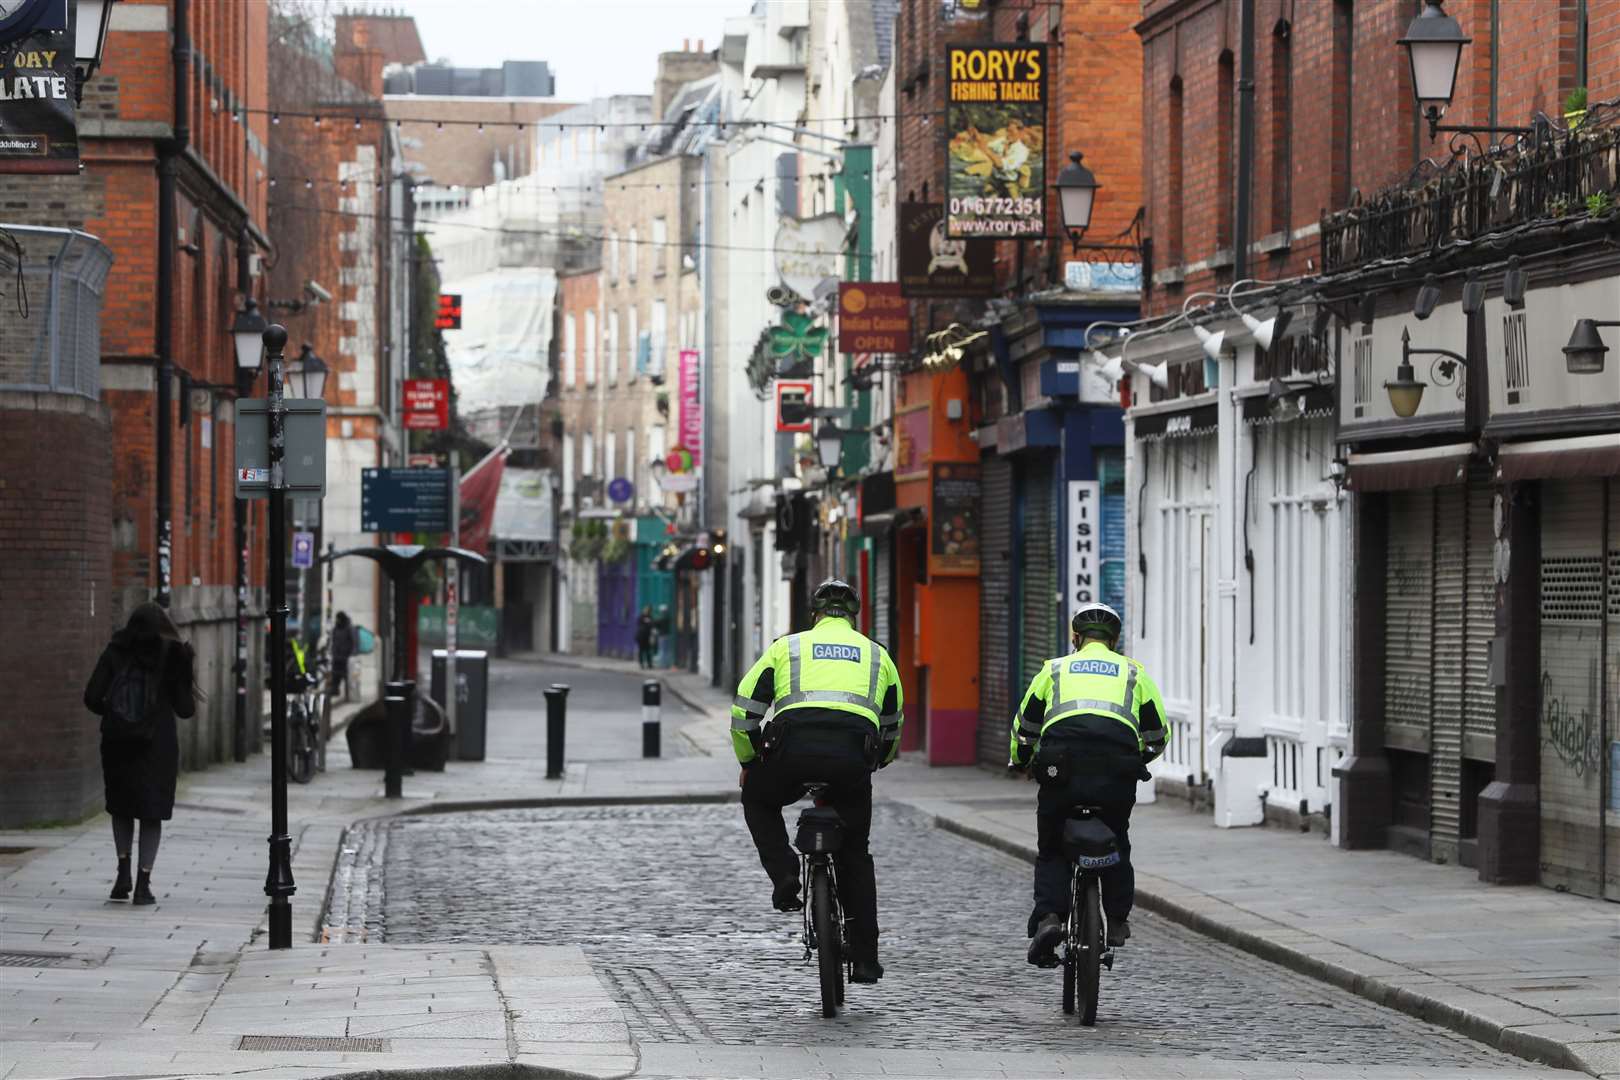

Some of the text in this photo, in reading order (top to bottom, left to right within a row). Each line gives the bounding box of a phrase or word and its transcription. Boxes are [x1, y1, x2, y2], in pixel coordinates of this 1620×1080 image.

[14, 51, 57, 68] DAY
[951, 49, 1040, 81] RORY'S
[0, 76, 67, 100] LATE
[951, 82, 1040, 101] FISHING TACKLE
[949, 218, 1043, 236] www.rorys.ie
[854, 336, 896, 350] OPEN
[1077, 489, 1092, 603] FISHING
[814, 645, 859, 660] GARDA
[1071, 661, 1117, 675] GARDA
